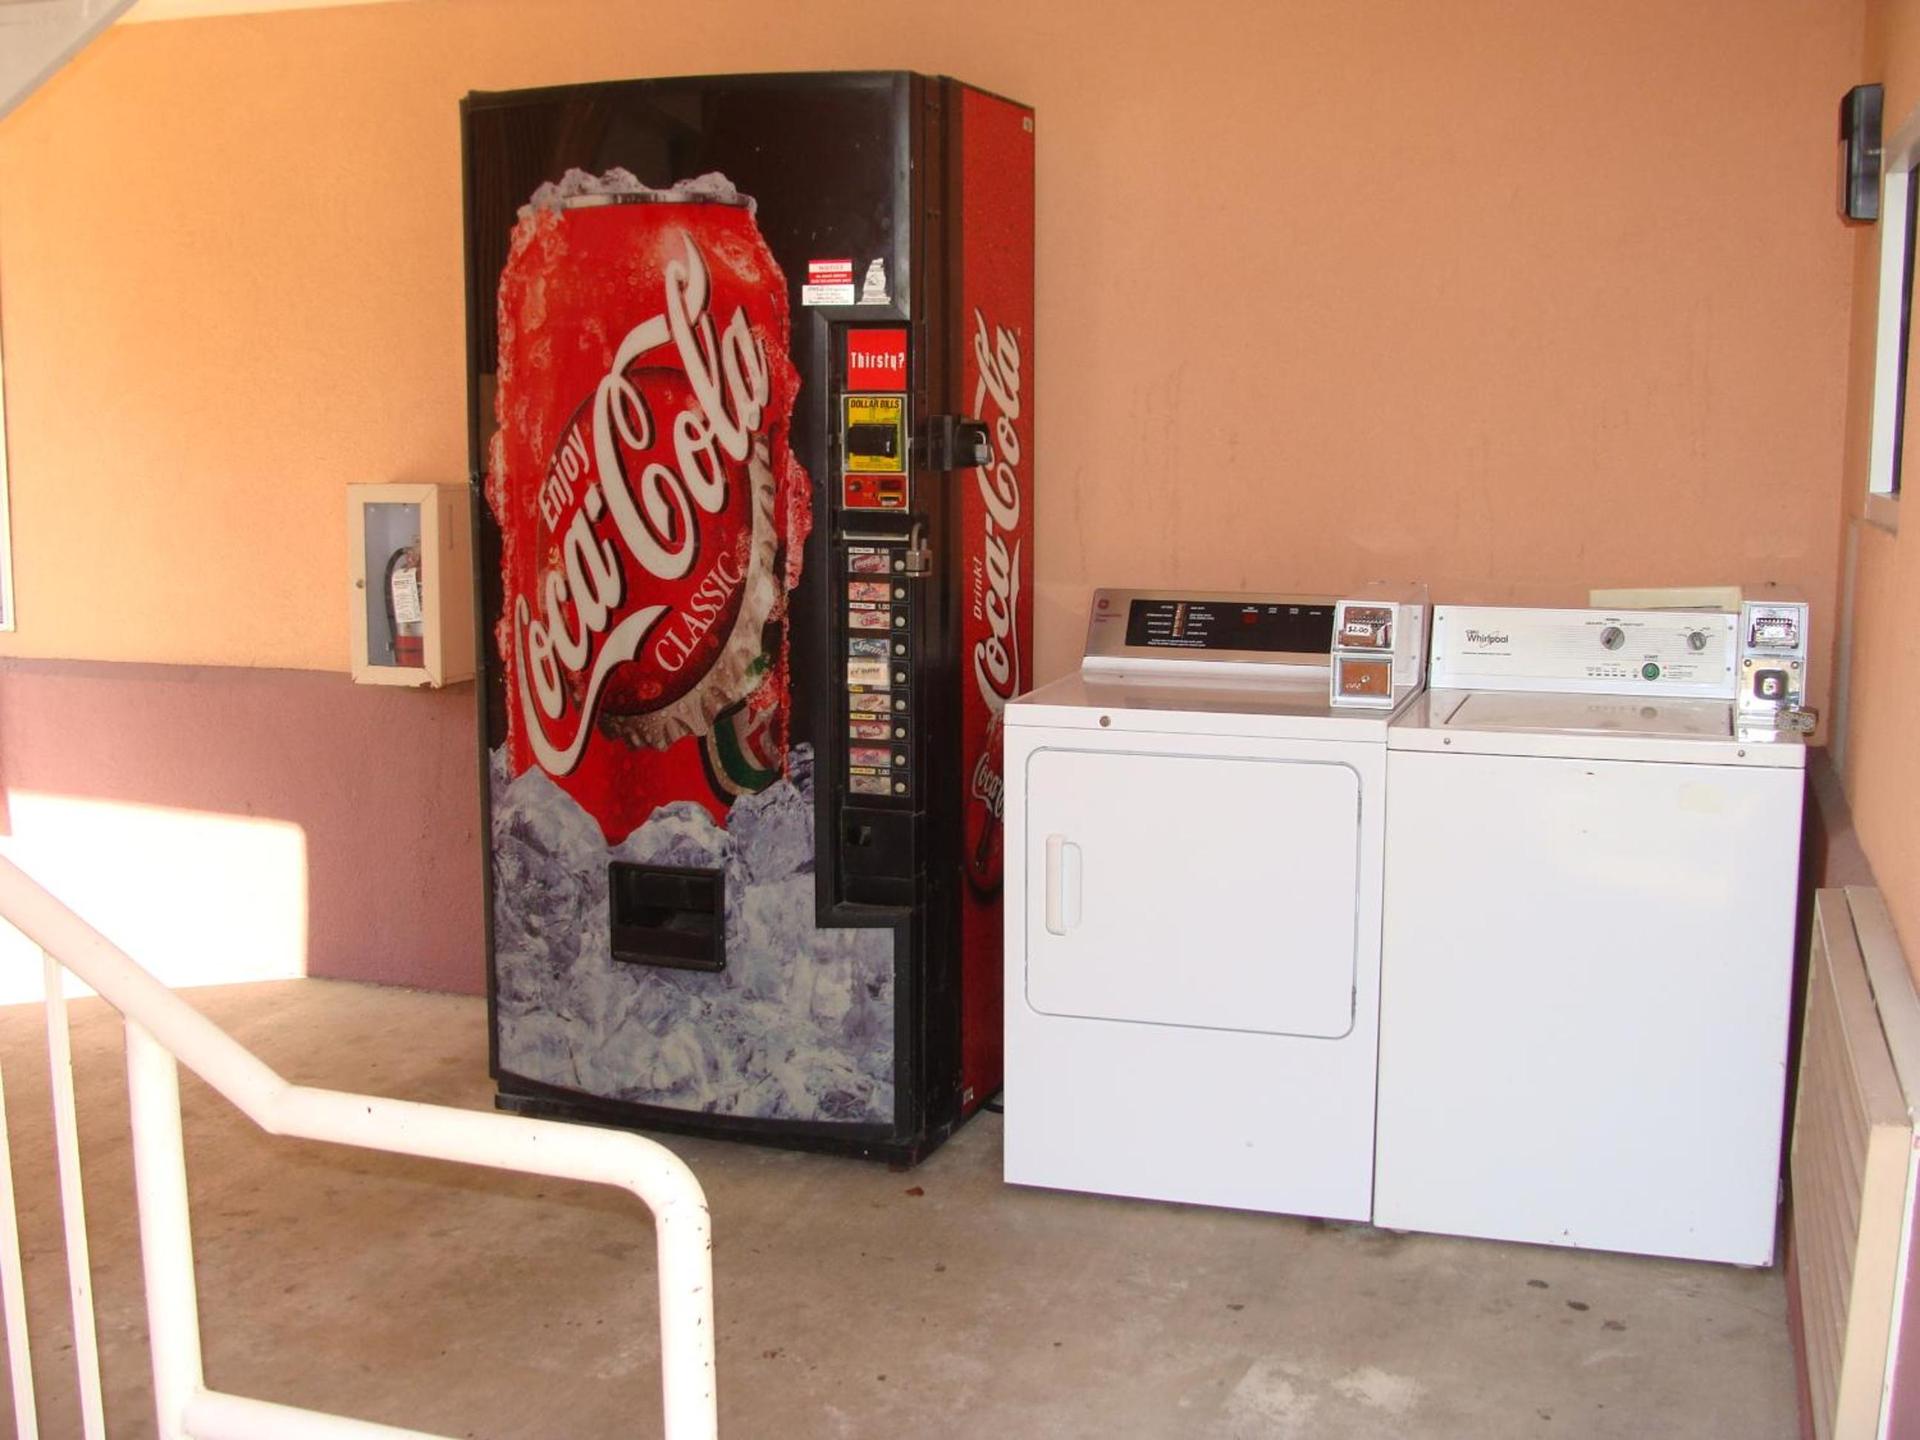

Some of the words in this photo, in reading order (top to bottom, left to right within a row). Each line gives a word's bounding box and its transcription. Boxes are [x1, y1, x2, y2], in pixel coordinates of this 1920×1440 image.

[850, 351, 905, 371] Thirsty?
[850, 399, 879, 409] DOLLAR
[880, 399, 900, 409] BILLS
[512, 230, 770, 777] Coca-Cola
[538, 422, 586, 533] Enjoy
[654, 551, 745, 673] CLASSIC
[973, 556, 984, 621] Drink!
[1465, 630, 1509, 645] Whirlpool
